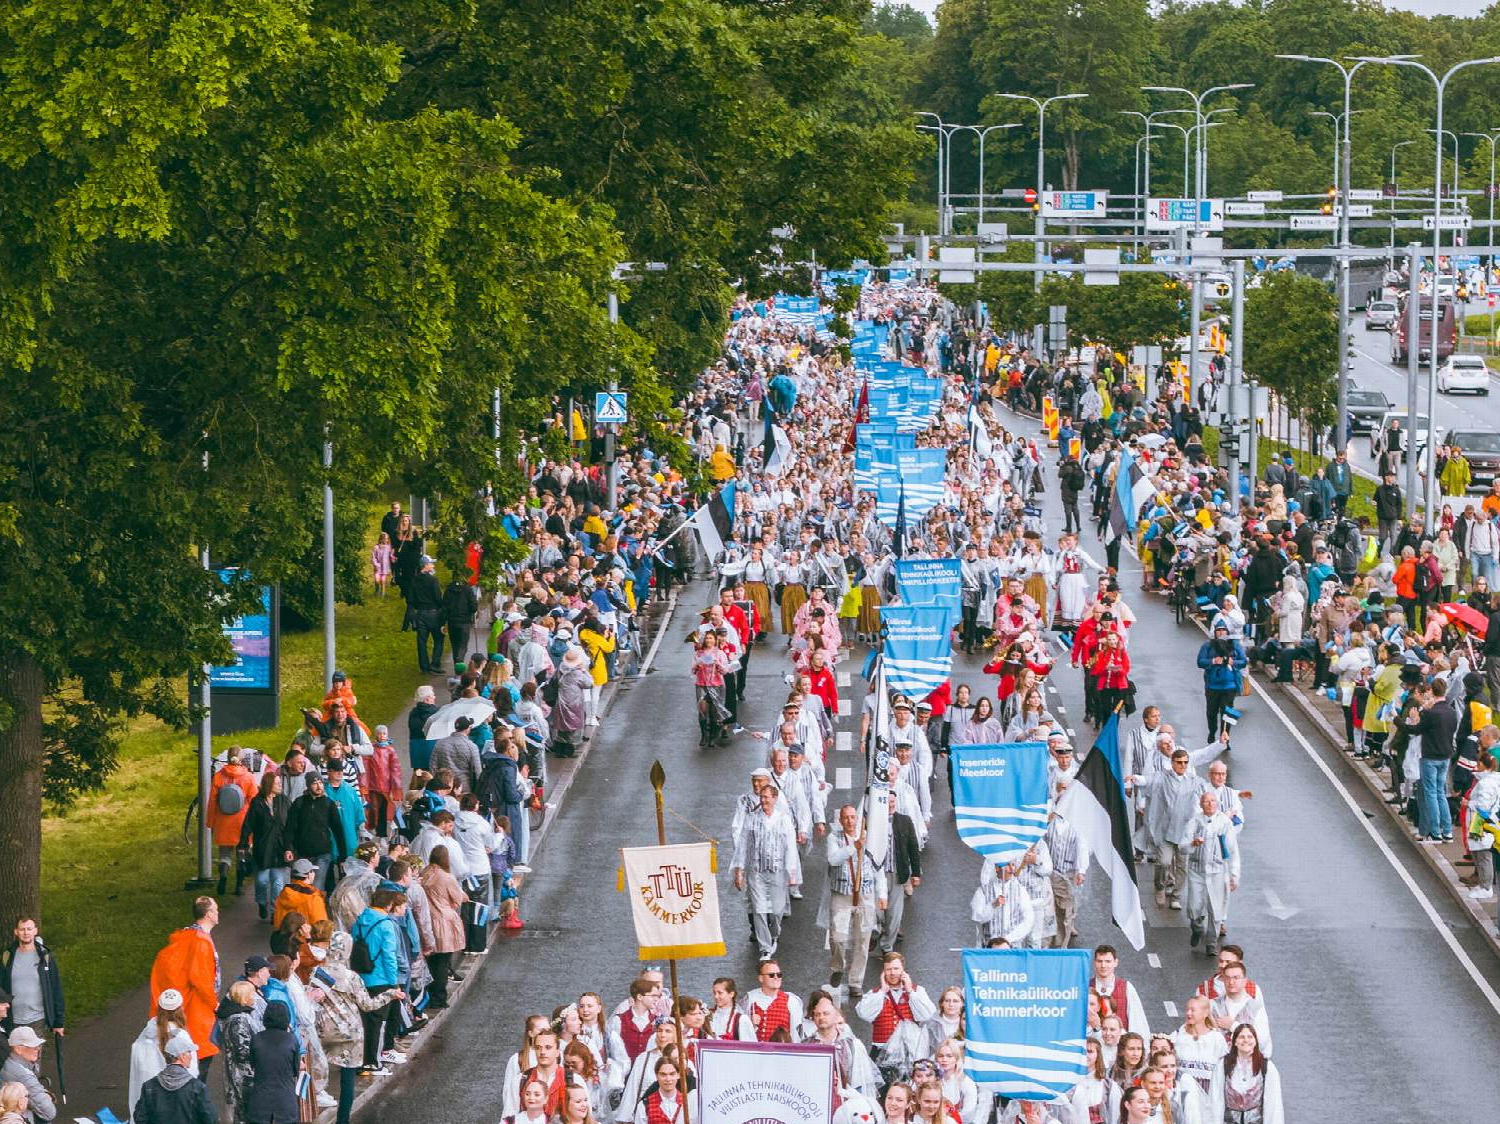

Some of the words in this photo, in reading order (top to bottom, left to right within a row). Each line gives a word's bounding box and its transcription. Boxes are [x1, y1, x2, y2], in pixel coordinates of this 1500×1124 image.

[913, 563, 943, 571] TALLINNA
[959, 758, 1006, 767] Inseneride
[959, 768, 1005, 777] Meeskoor
[647, 864, 693, 899] TTÜ
[640, 881, 704, 925] KAMMERKOOR
[971, 968, 1028, 983] Tallinna
[972, 986, 1079, 1001] Tehnikaülikooli
[972, 1003, 1068, 1018] Kammerkoor
[707, 1083, 746, 1112] TALLINNA
[747, 1081, 823, 1118] TEHNIKAÜLIKOOLI
[719, 1093, 765, 1116] VILISTLASTE
[766, 1092, 811, 1121] NAISKOOR
